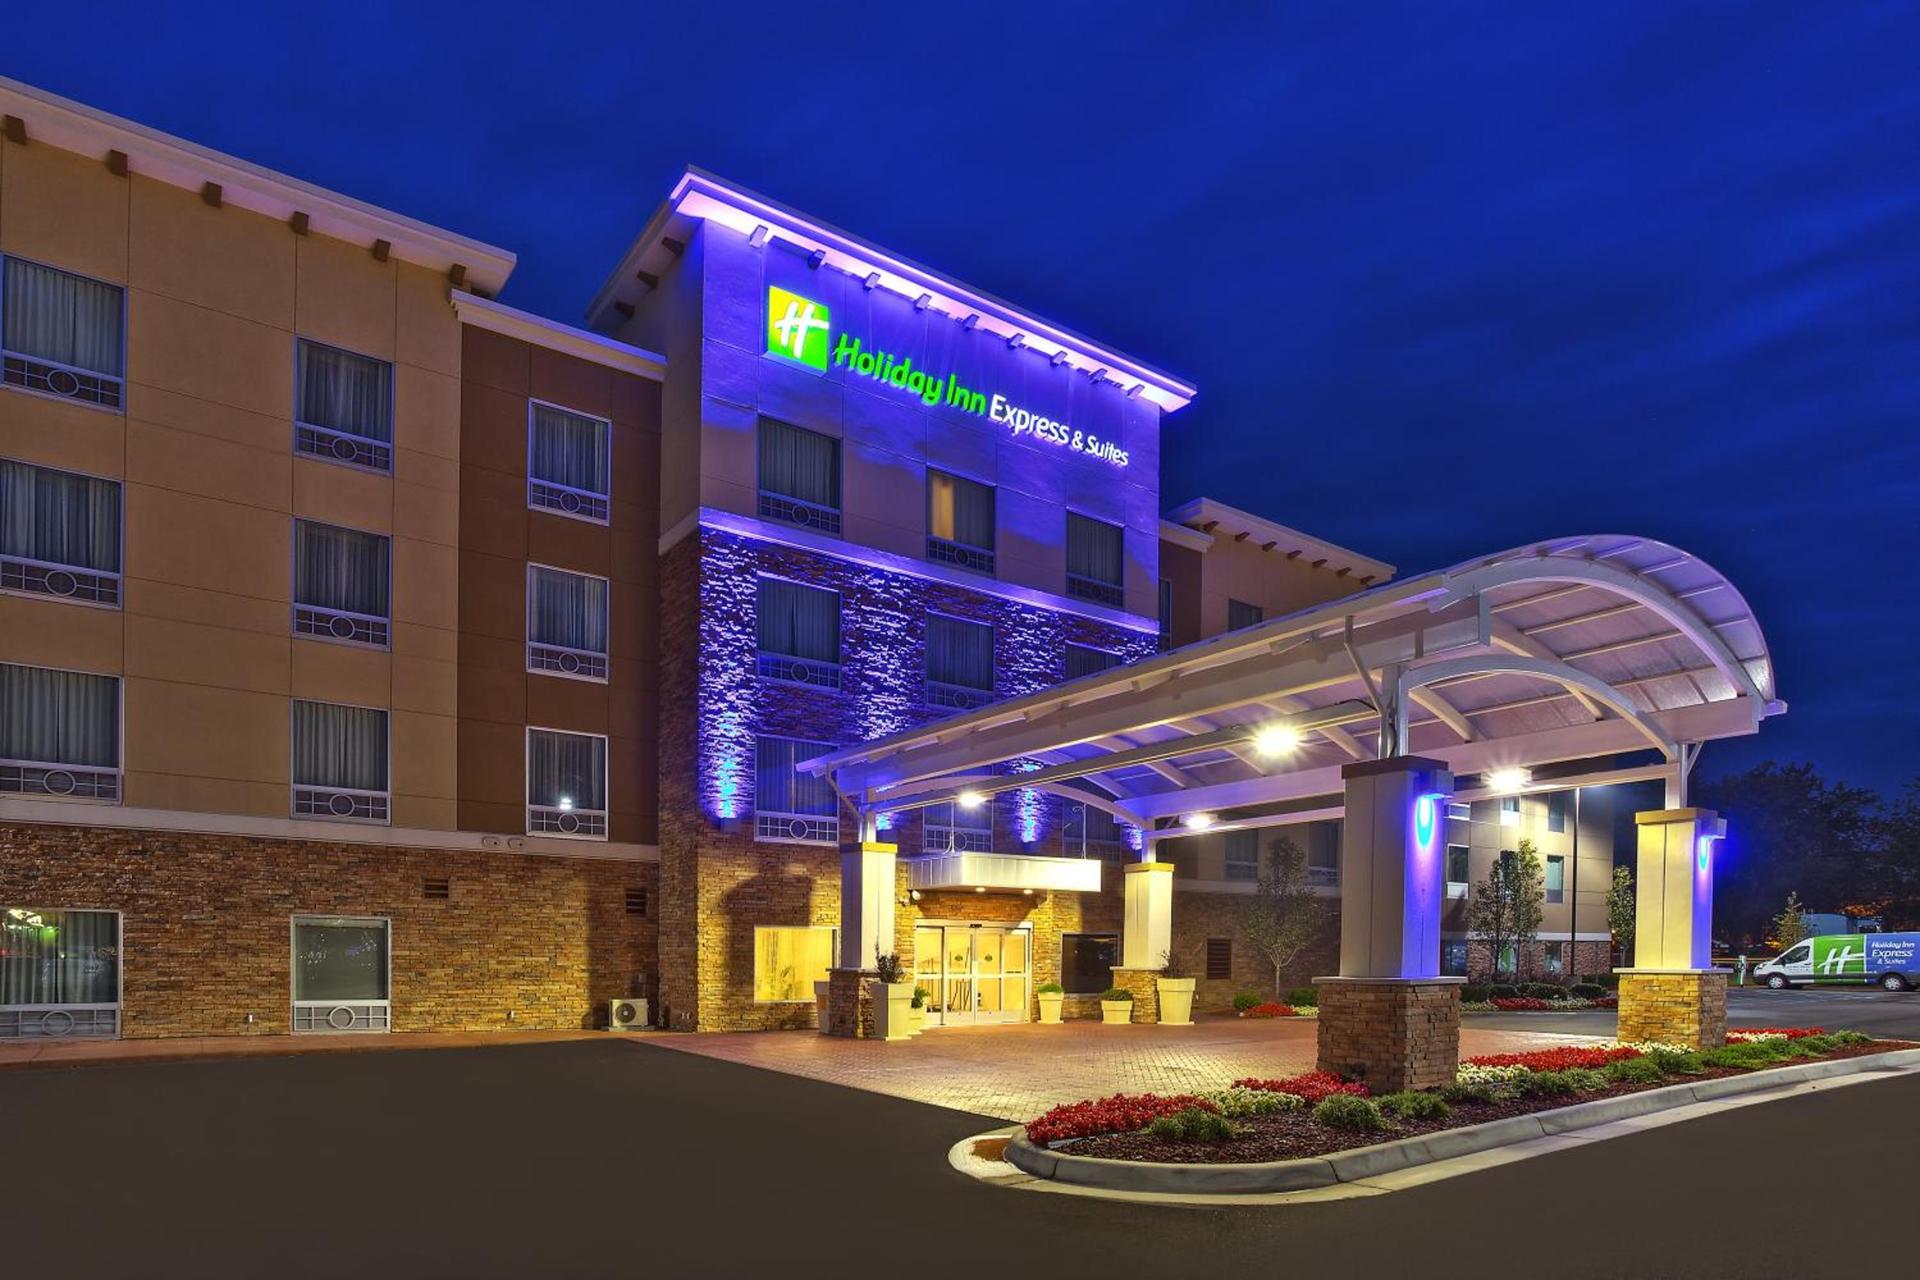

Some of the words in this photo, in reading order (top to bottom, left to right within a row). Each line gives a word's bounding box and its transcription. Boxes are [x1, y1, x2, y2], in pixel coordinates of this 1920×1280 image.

[833, 332, 943, 406] Holiday
[946, 373, 987, 415] Inn
[989, 394, 1070, 444] Express
[1071, 430, 1084, 450] &
[1086, 435, 1129, 466] Suites
[1872, 941, 1901, 949] Holiday
[1872, 949, 1913, 959] Express
